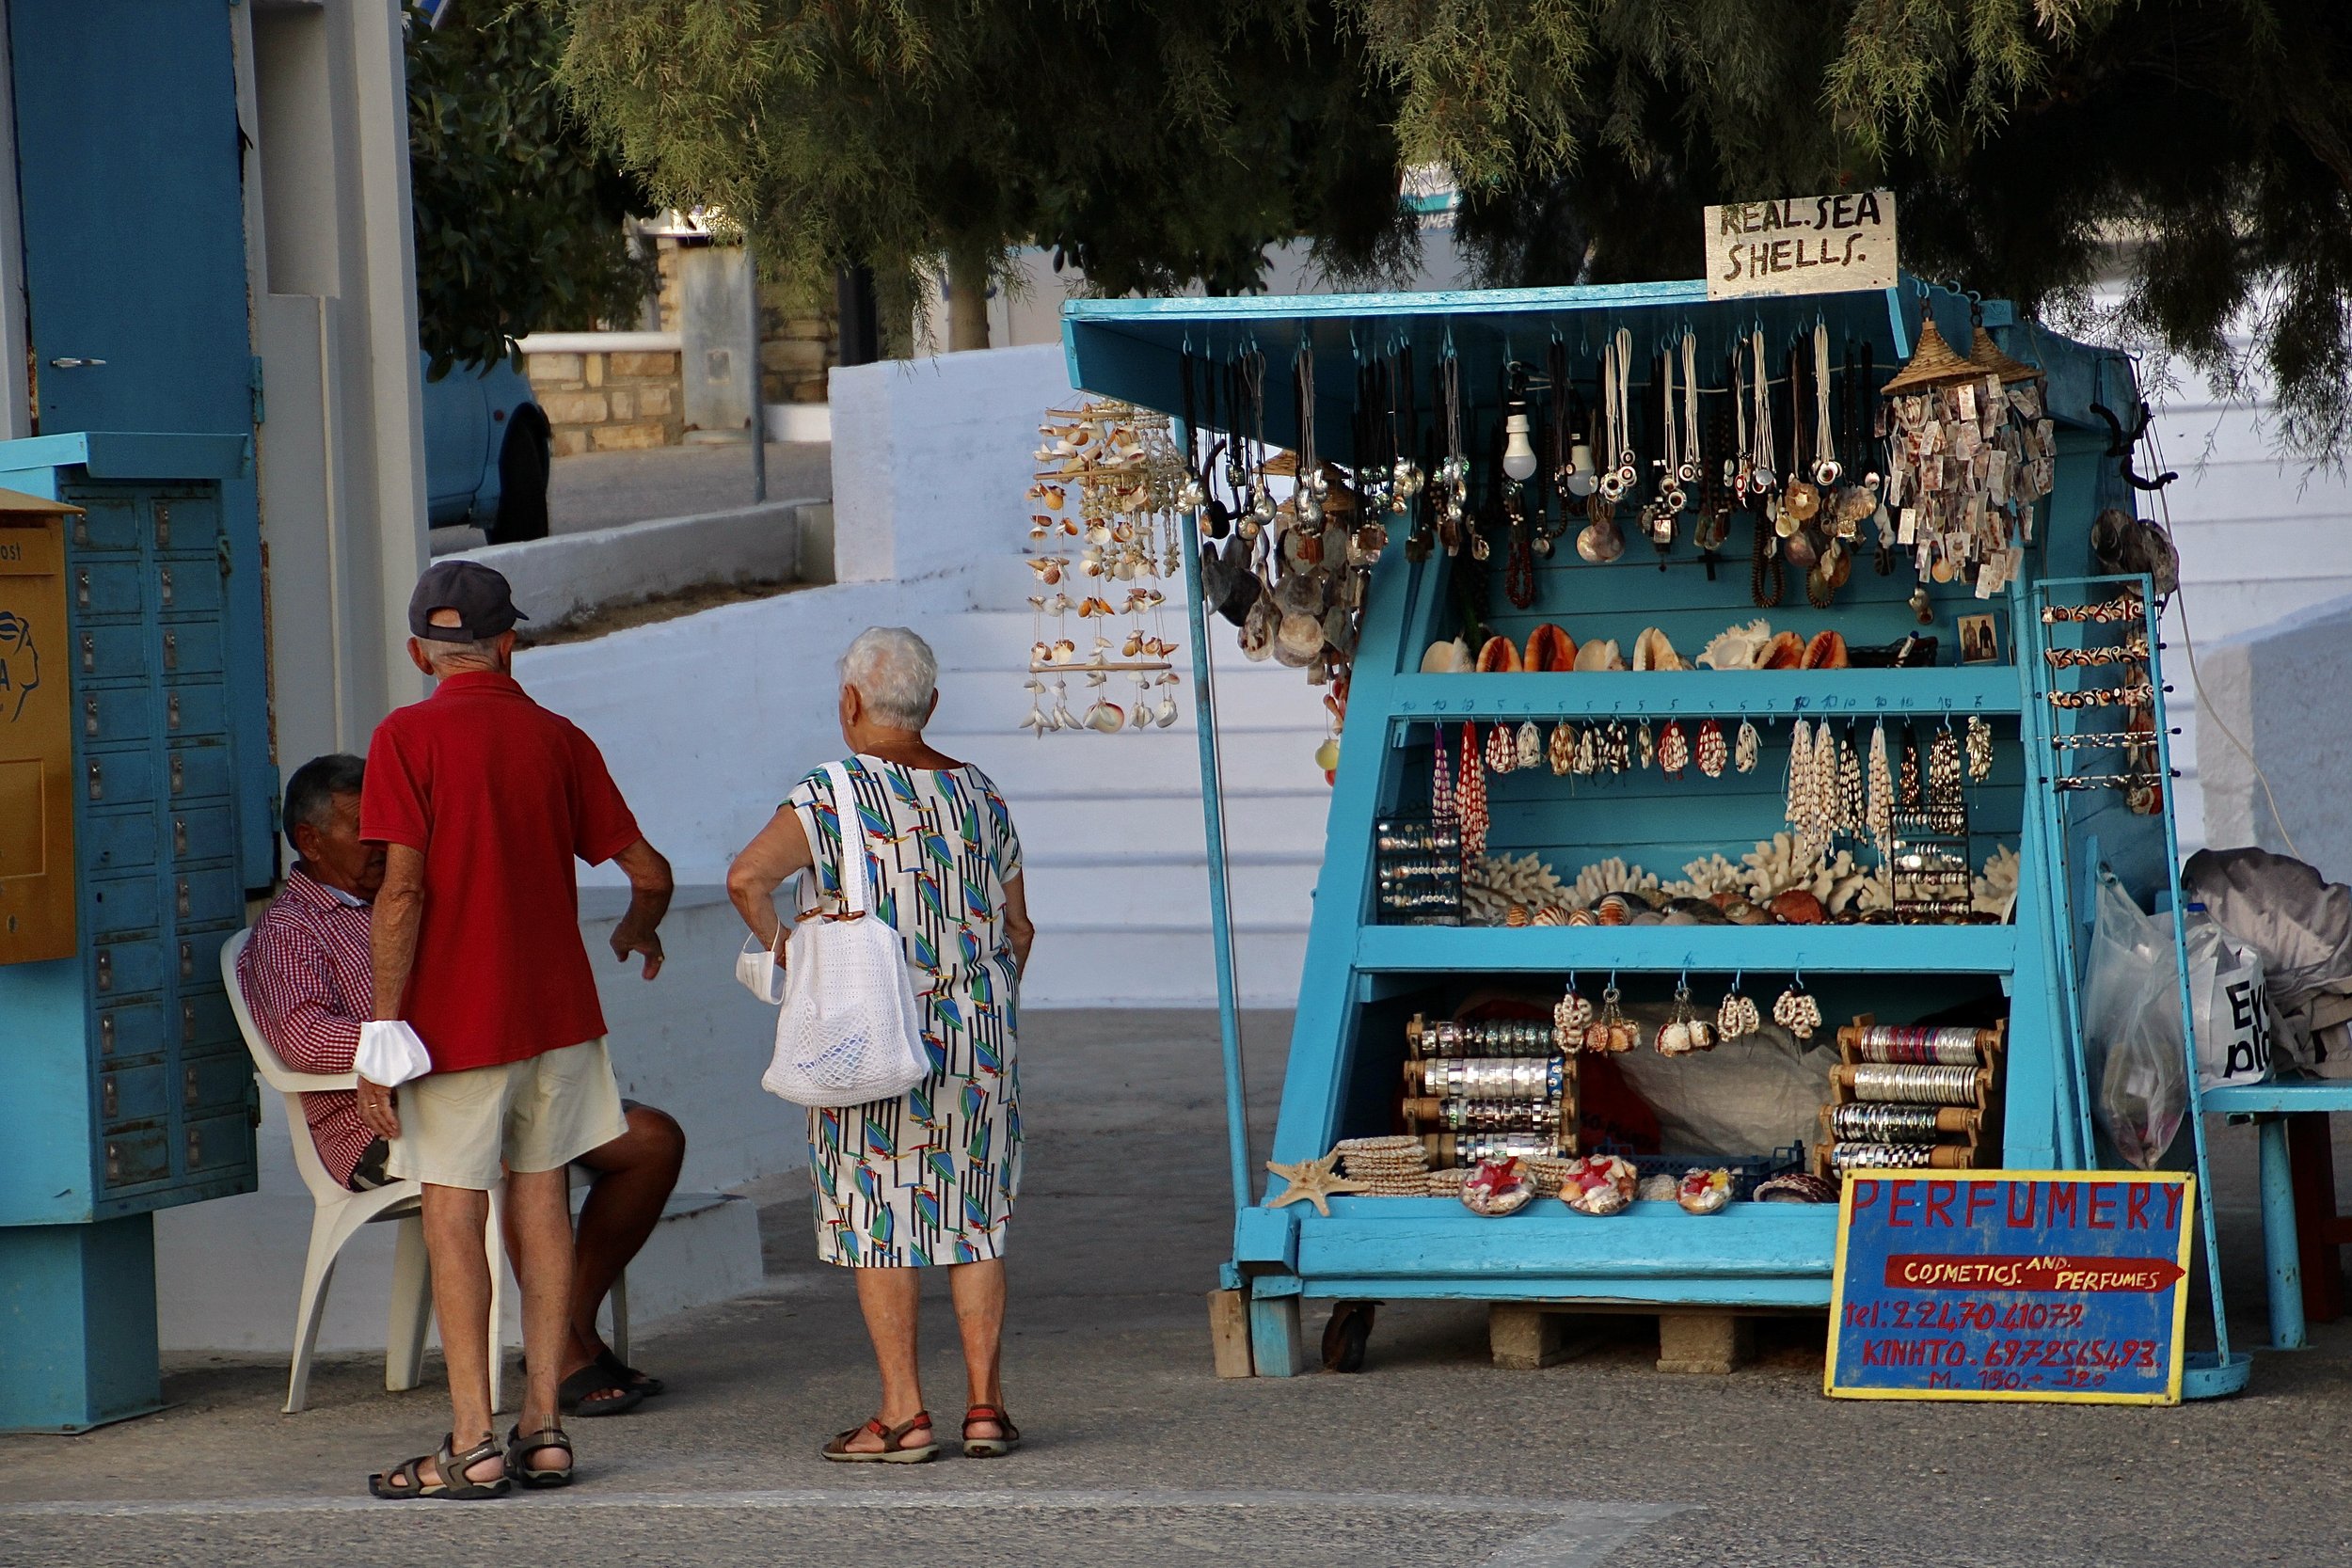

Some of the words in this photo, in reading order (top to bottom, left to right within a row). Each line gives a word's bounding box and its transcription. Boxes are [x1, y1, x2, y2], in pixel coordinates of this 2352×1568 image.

[1724, 232, 1867, 281] SHELLS.
[1613, 701, 1621, 712] 5
[1638, 700, 1645, 712] 5
[1669, 698, 1678, 710] 5
[1739, 700, 1747, 711] 5
[1850, 1180, 2185, 1229] PERFUMERY
[2055, 1271, 2160, 1291] PERFUMES
